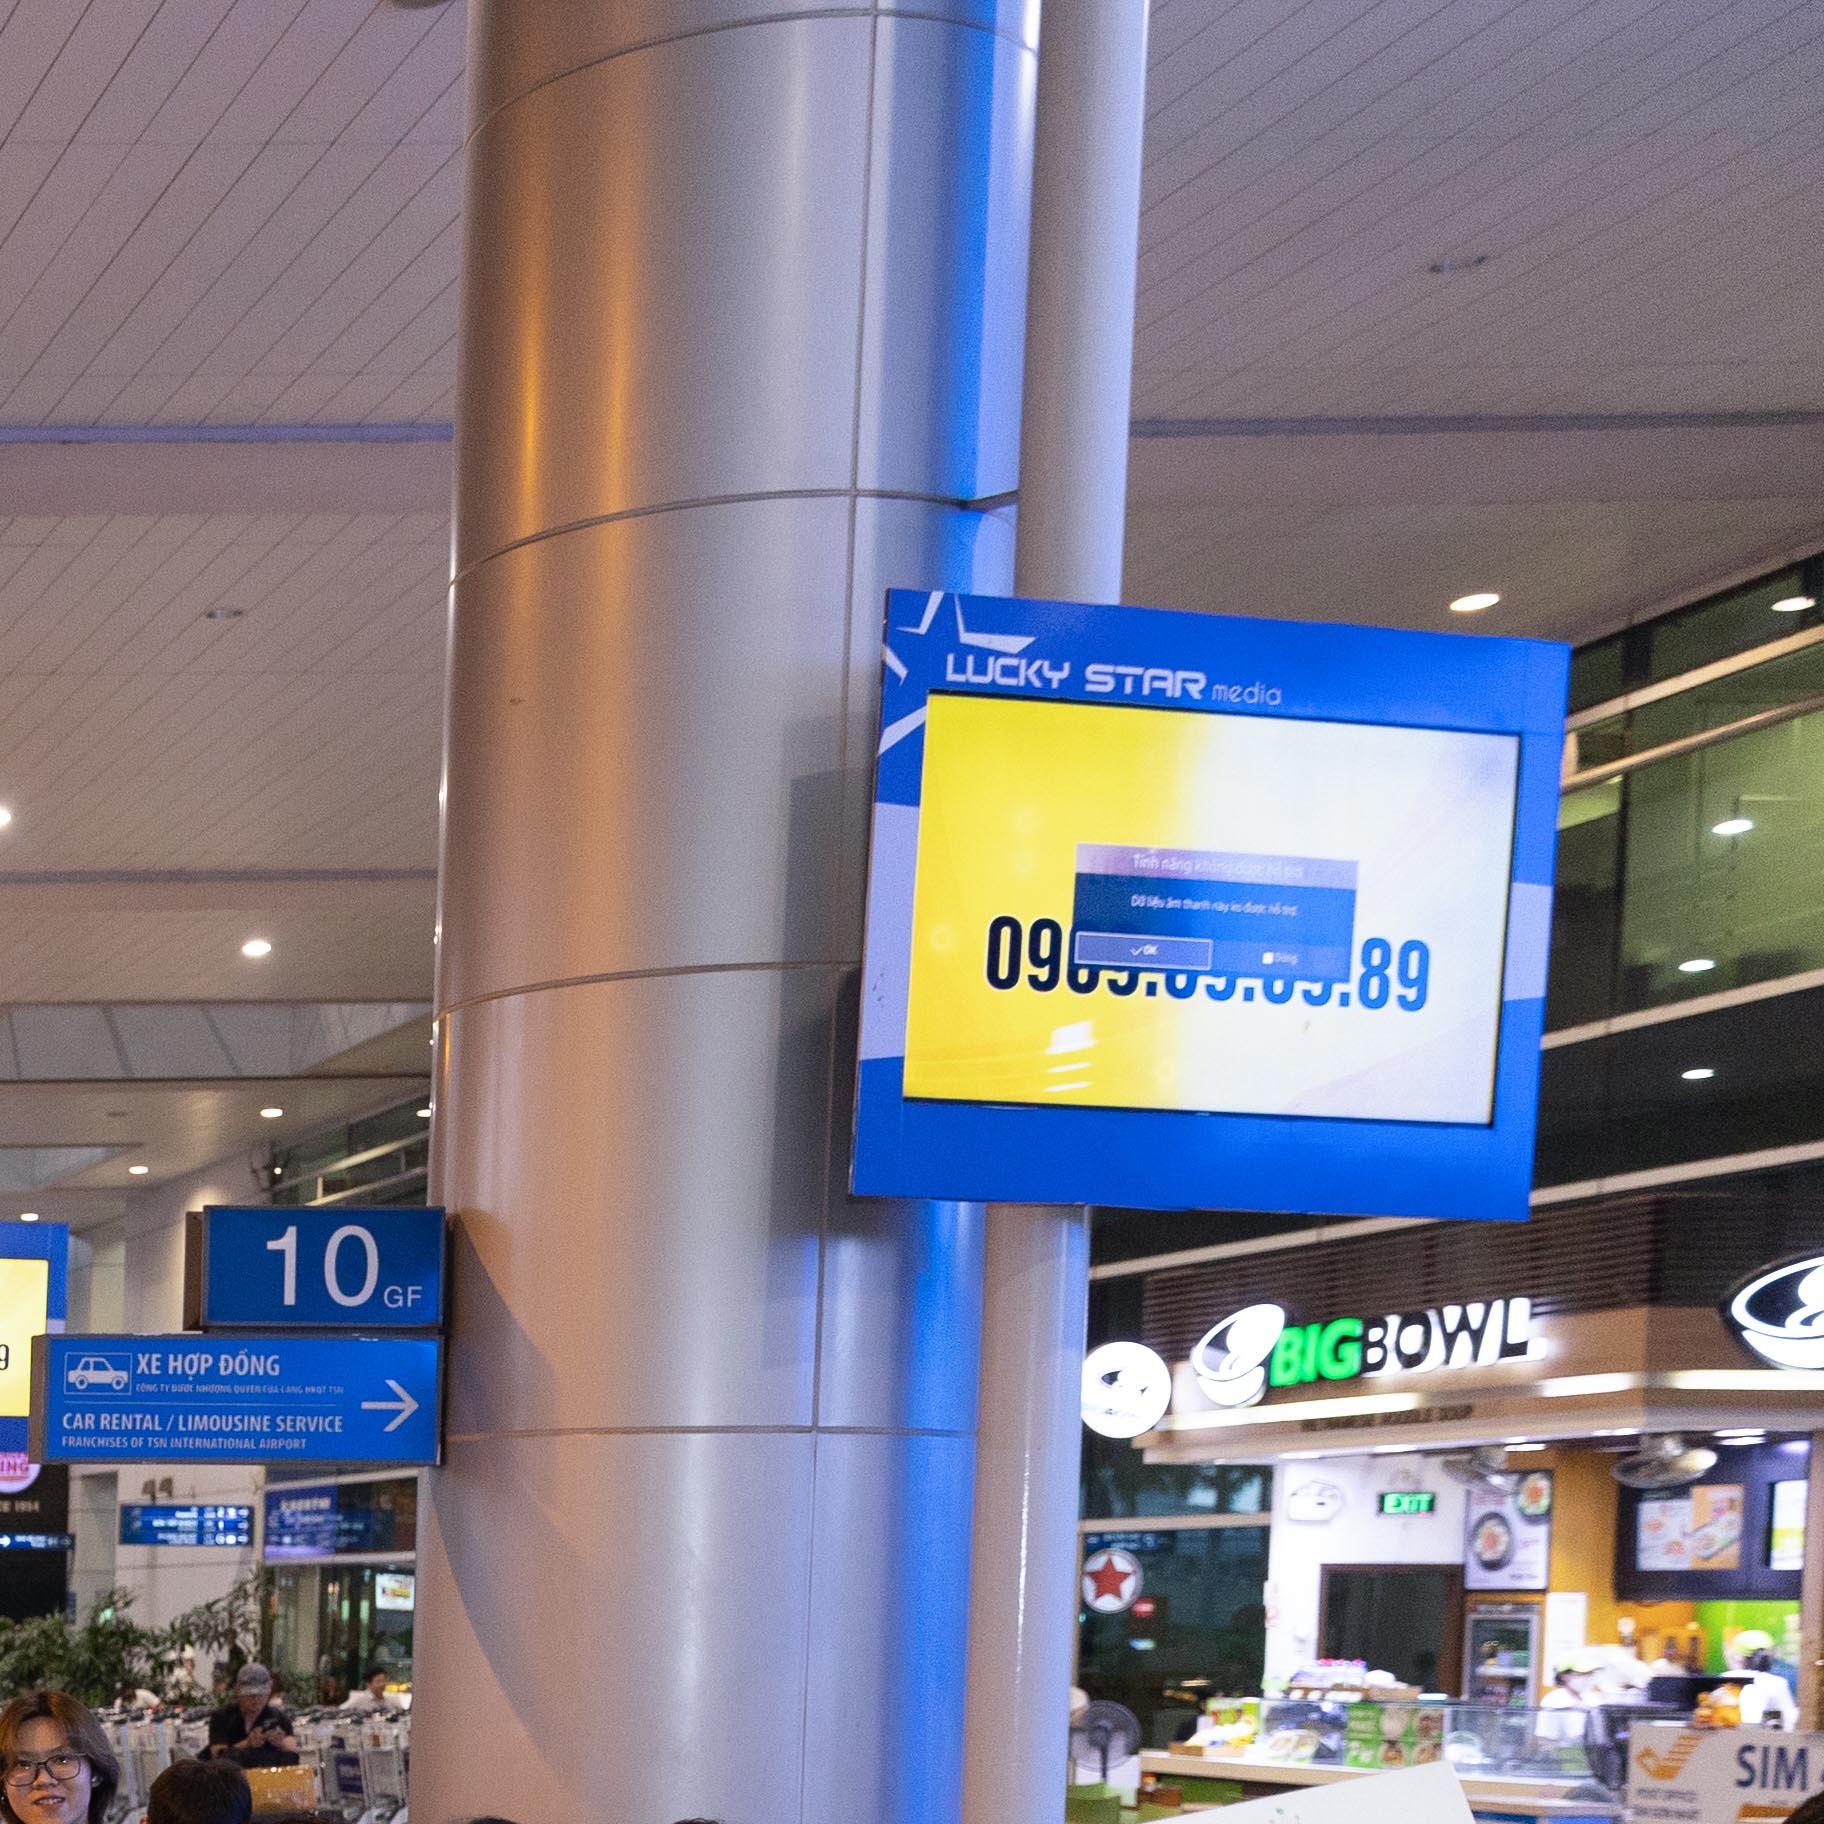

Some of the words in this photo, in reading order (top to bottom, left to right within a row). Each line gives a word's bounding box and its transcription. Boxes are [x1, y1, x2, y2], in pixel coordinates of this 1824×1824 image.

[946, 653, 1071, 689] LUCKY
[1085, 664, 1206, 699] STAR
[1212, 681, 1282, 705] media
[986, 915, 1430, 1012] 09...89
[266, 1225, 379, 1307] 10
[383, 1285, 423, 1309] GF
[137, 1354, 161, 1374] XE
[168, 1352, 213, 1381] HỢP
[219, 1348, 280, 1376] ĐỒNG
[62, 1436, 127, 1448] FRANCHISES
[131, 1437, 144, 1448] OF
[147, 1437, 167, 1449] TSN
[170, 1437, 256, 1449] INTERNATIONAL
[259, 1438, 307, 1449] AIRPORT
[63, 1413, 95, 1430] CAR
[101, 1413, 161, 1431] RENTAL
[178, 1414, 270, 1432] LIMOUSINE
[276, 1415, 343, 1433] SERVICE
[1736, 1744, 1809, 1791] SIM
